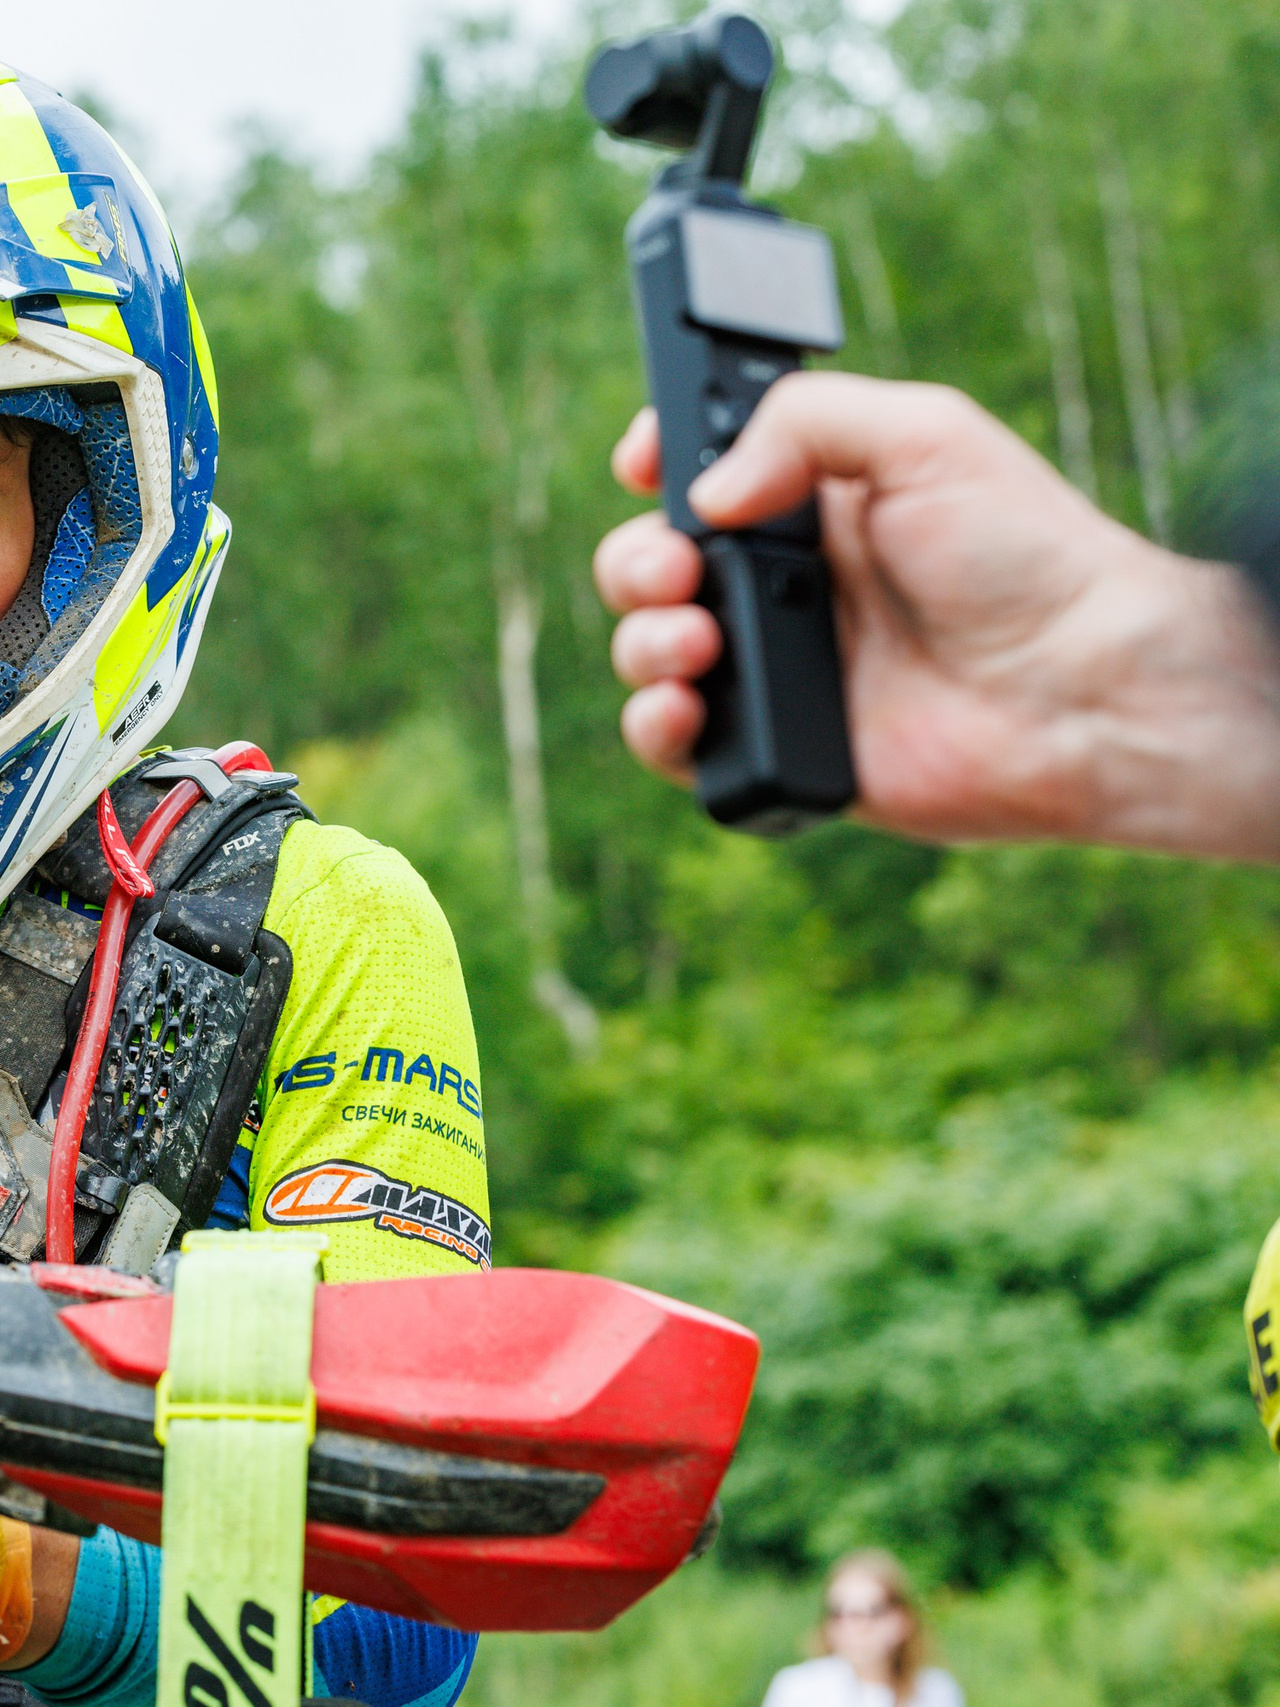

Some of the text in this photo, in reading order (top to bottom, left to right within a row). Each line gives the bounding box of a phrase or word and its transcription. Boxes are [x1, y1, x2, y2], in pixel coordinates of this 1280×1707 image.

[114, 690, 163, 746] EMERGENCY ONLY
[124, 693, 151, 729] AEFR
[222, 831, 262, 856] FOX
[342, 1105, 485, 1164] СВЕЧИ ЗАЖИГАНИ
[380, 1215, 478, 1259] RACING
